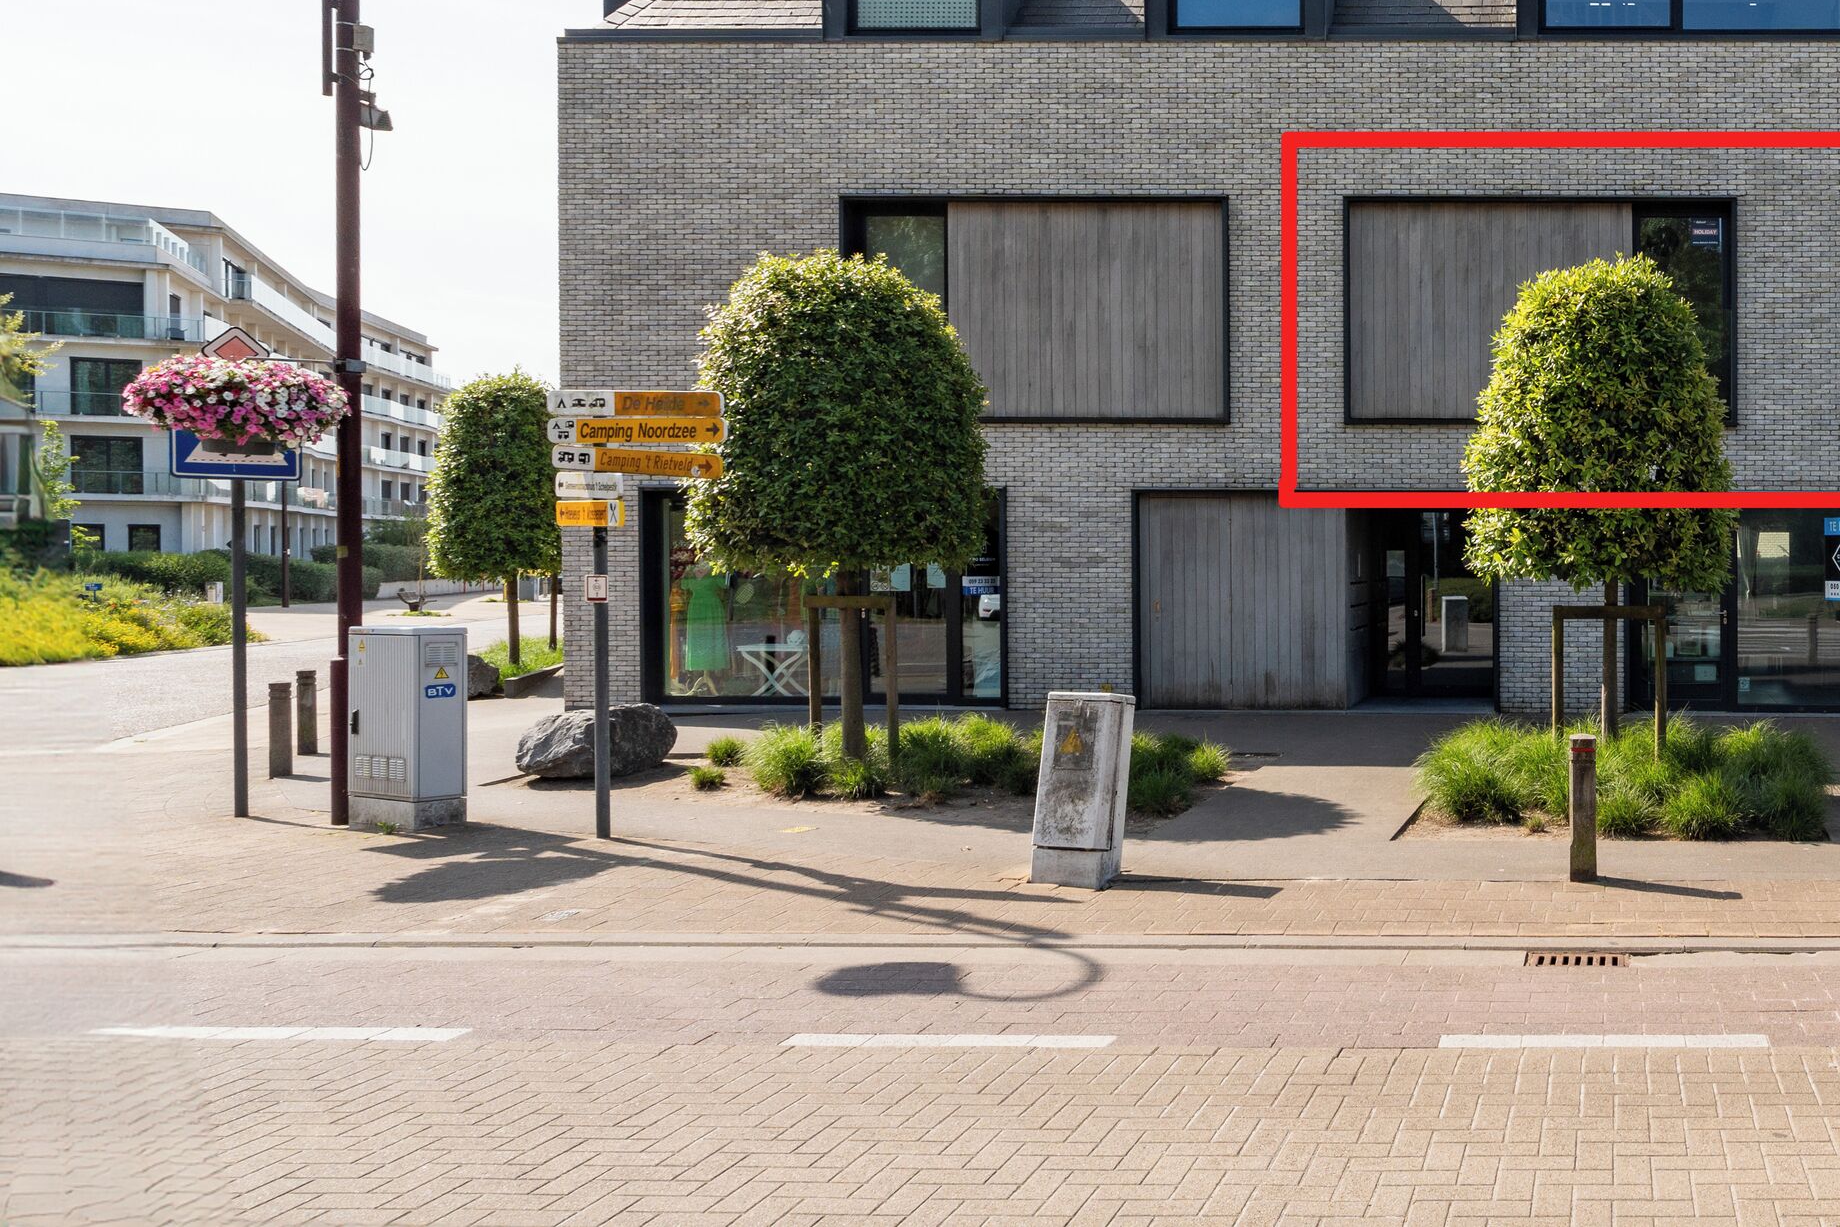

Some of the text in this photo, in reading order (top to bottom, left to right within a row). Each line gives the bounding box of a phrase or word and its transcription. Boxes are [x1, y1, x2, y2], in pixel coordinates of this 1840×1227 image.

[622, 396, 685, 411] De Heide
[580, 423, 697, 442] Camping Noordzee
[600, 452, 693, 471] Camping 't Rietveld
[1829, 521, 1837, 532] TE
[970, 586, 995, 594] TE HUUR
